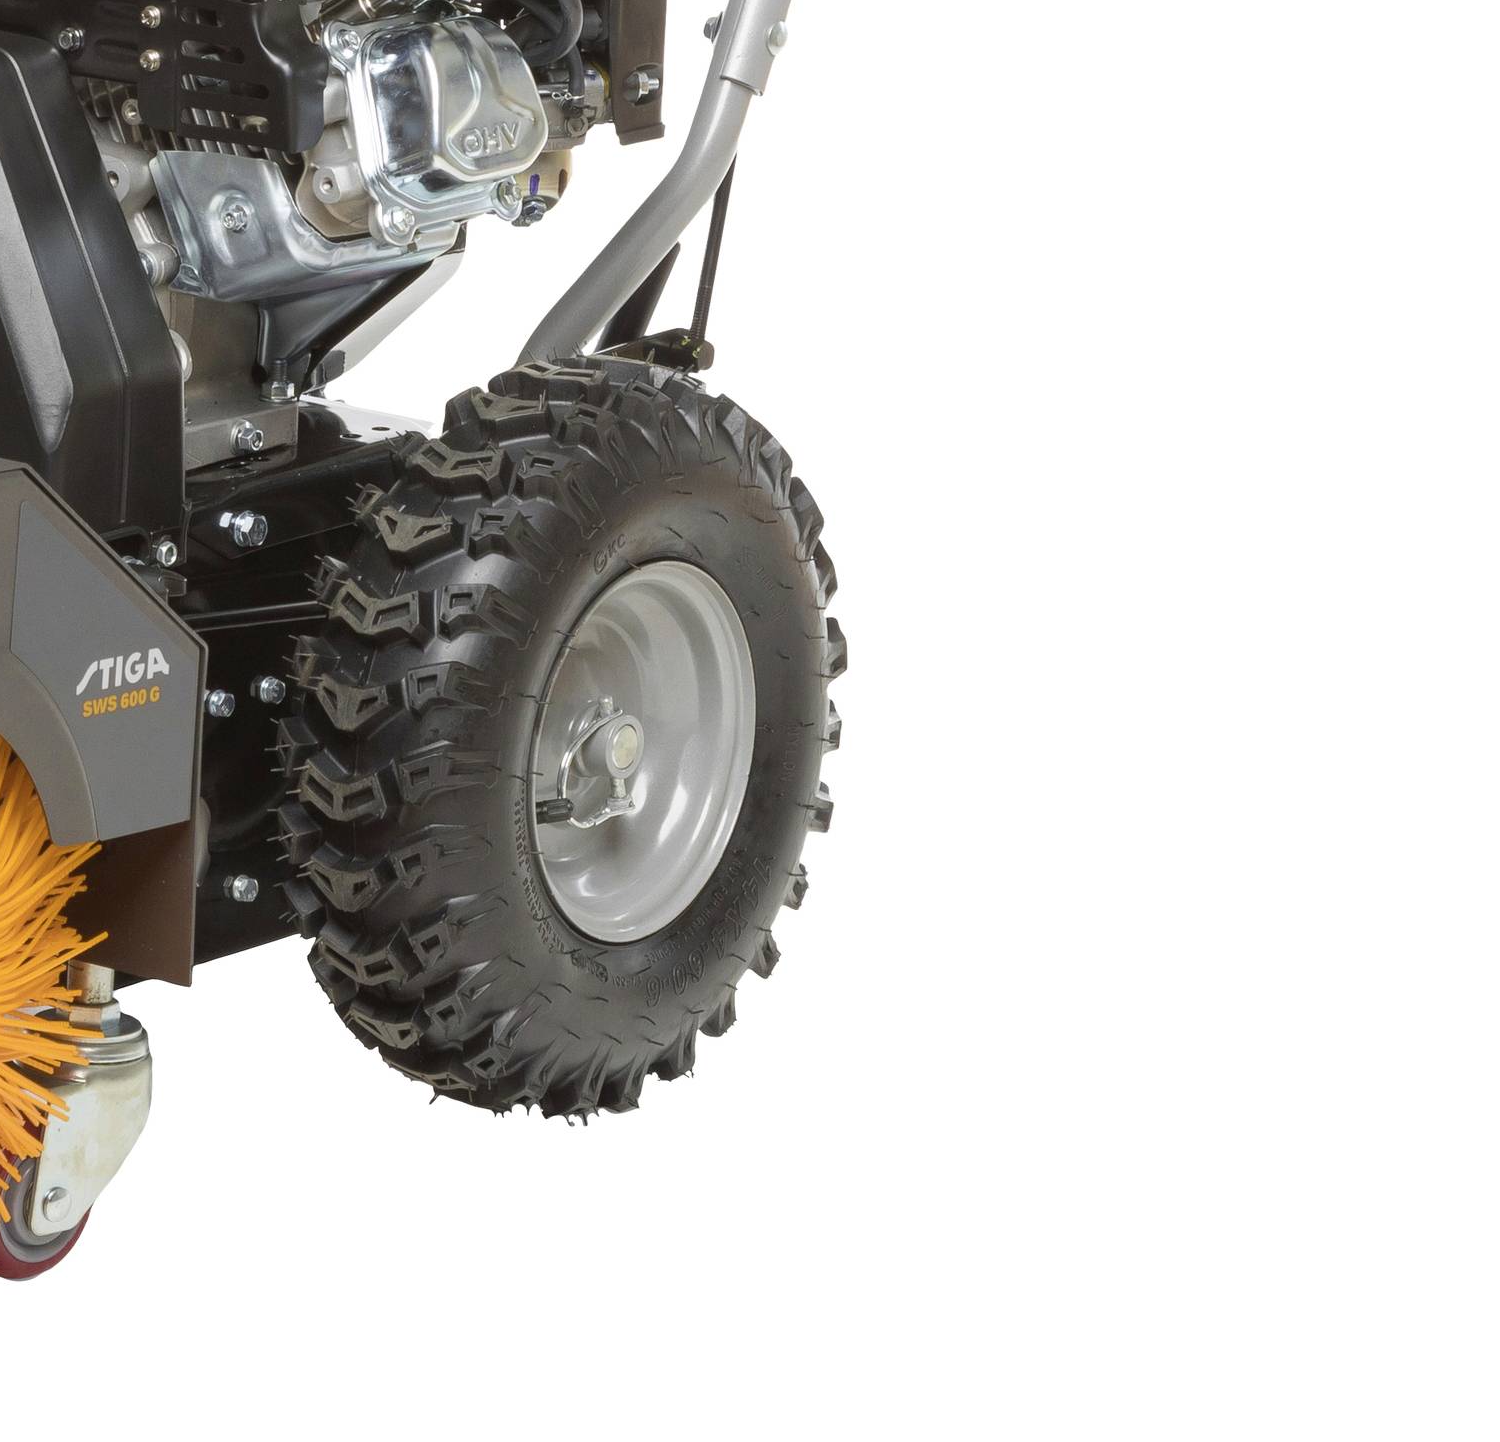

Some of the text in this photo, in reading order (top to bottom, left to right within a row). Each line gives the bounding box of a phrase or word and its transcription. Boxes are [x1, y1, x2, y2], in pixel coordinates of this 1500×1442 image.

[463, 121, 521, 158] OHV
[76, 647, 170, 696] STIGA
[82, 685, 161, 718] SWS 600 G
